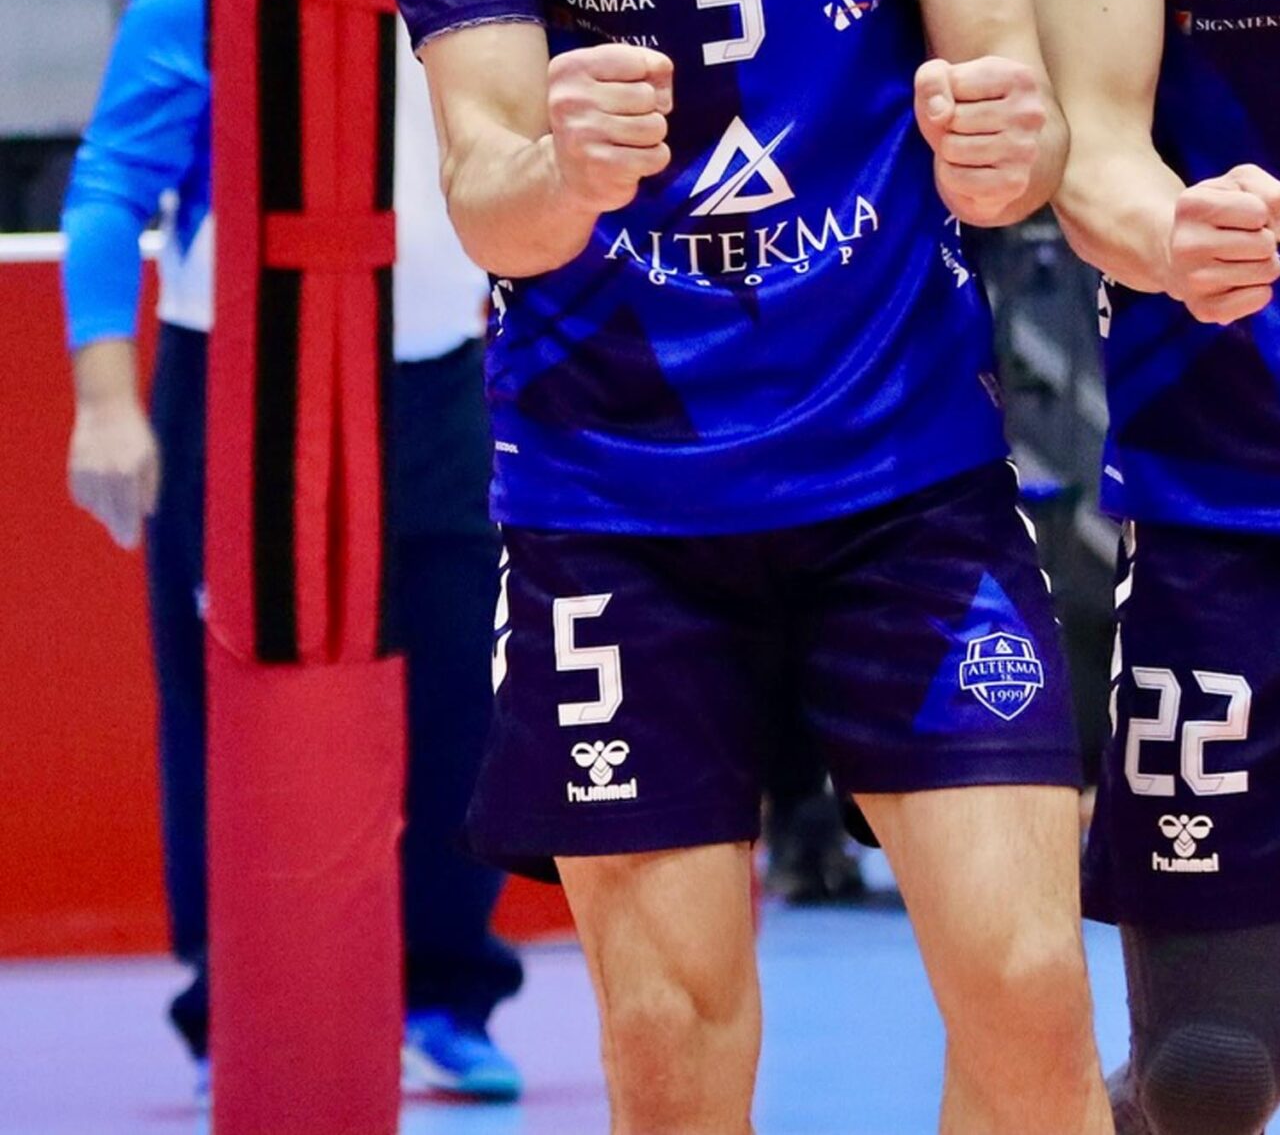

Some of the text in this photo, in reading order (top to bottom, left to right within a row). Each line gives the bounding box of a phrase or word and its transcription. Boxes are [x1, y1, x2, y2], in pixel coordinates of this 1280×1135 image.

[604, 195, 879, 277] ALTEKMA
[553, 593, 624, 727] 5
[968, 660, 1038, 677] ALTEKMA
[990, 688, 1025, 704] 1999
[1124, 666, 1253, 797] 22
[567, 776, 638, 803] hummel
[1152, 851, 1220, 873] hummel
